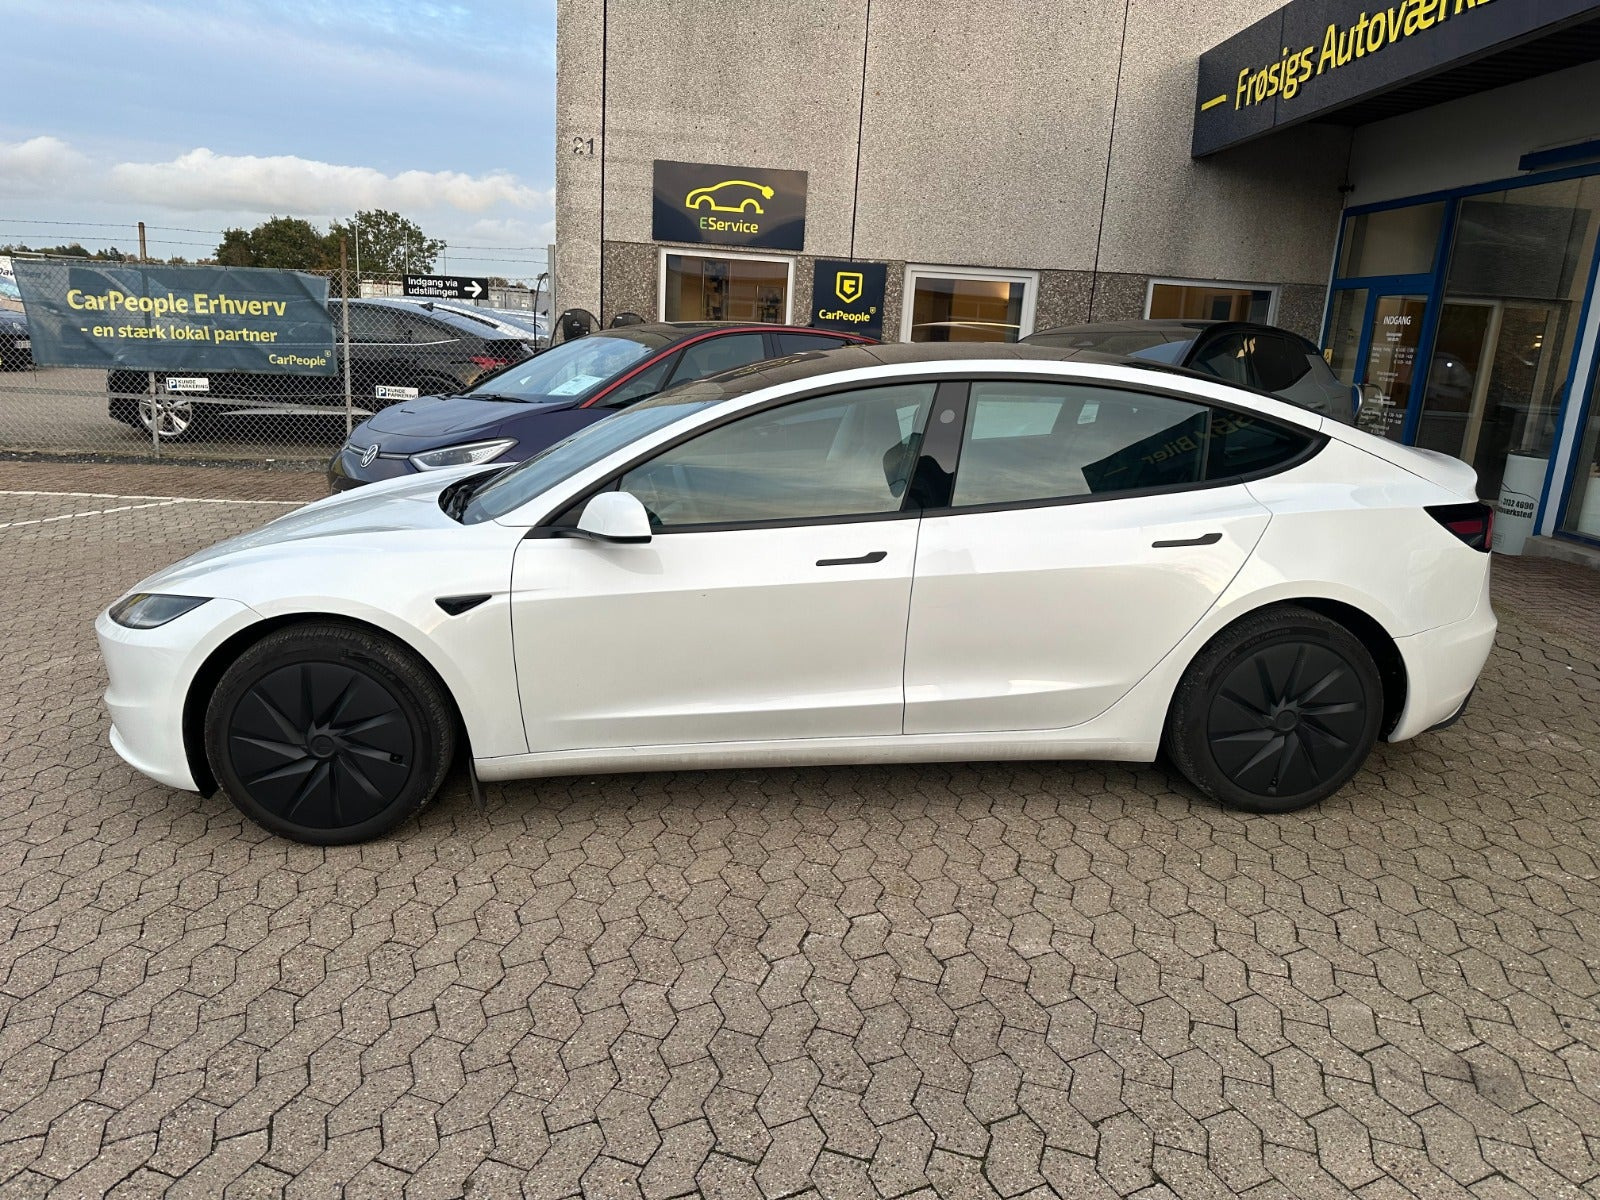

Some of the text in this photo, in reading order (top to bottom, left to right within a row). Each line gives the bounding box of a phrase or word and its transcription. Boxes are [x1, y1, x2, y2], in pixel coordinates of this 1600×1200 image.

[1234, 45, 1314, 110] Frøsigs
[699, 217, 759, 234] EService
[408, 276, 458, 288] Indgang via
[408, 287, 458, 298] udstillingen
[66, 289, 287, 318] CarPeople Erhverv
[819, 309, 871, 324] CarPeople
[1383, 315, 1412, 325] INDGANG
[93, 326, 113, 338] en
[118, 325, 167, 340] stærk
[170, 326, 209, 341] lokal
[215, 328, 278, 345] partner
[269, 354, 326, 368] CarPeople
